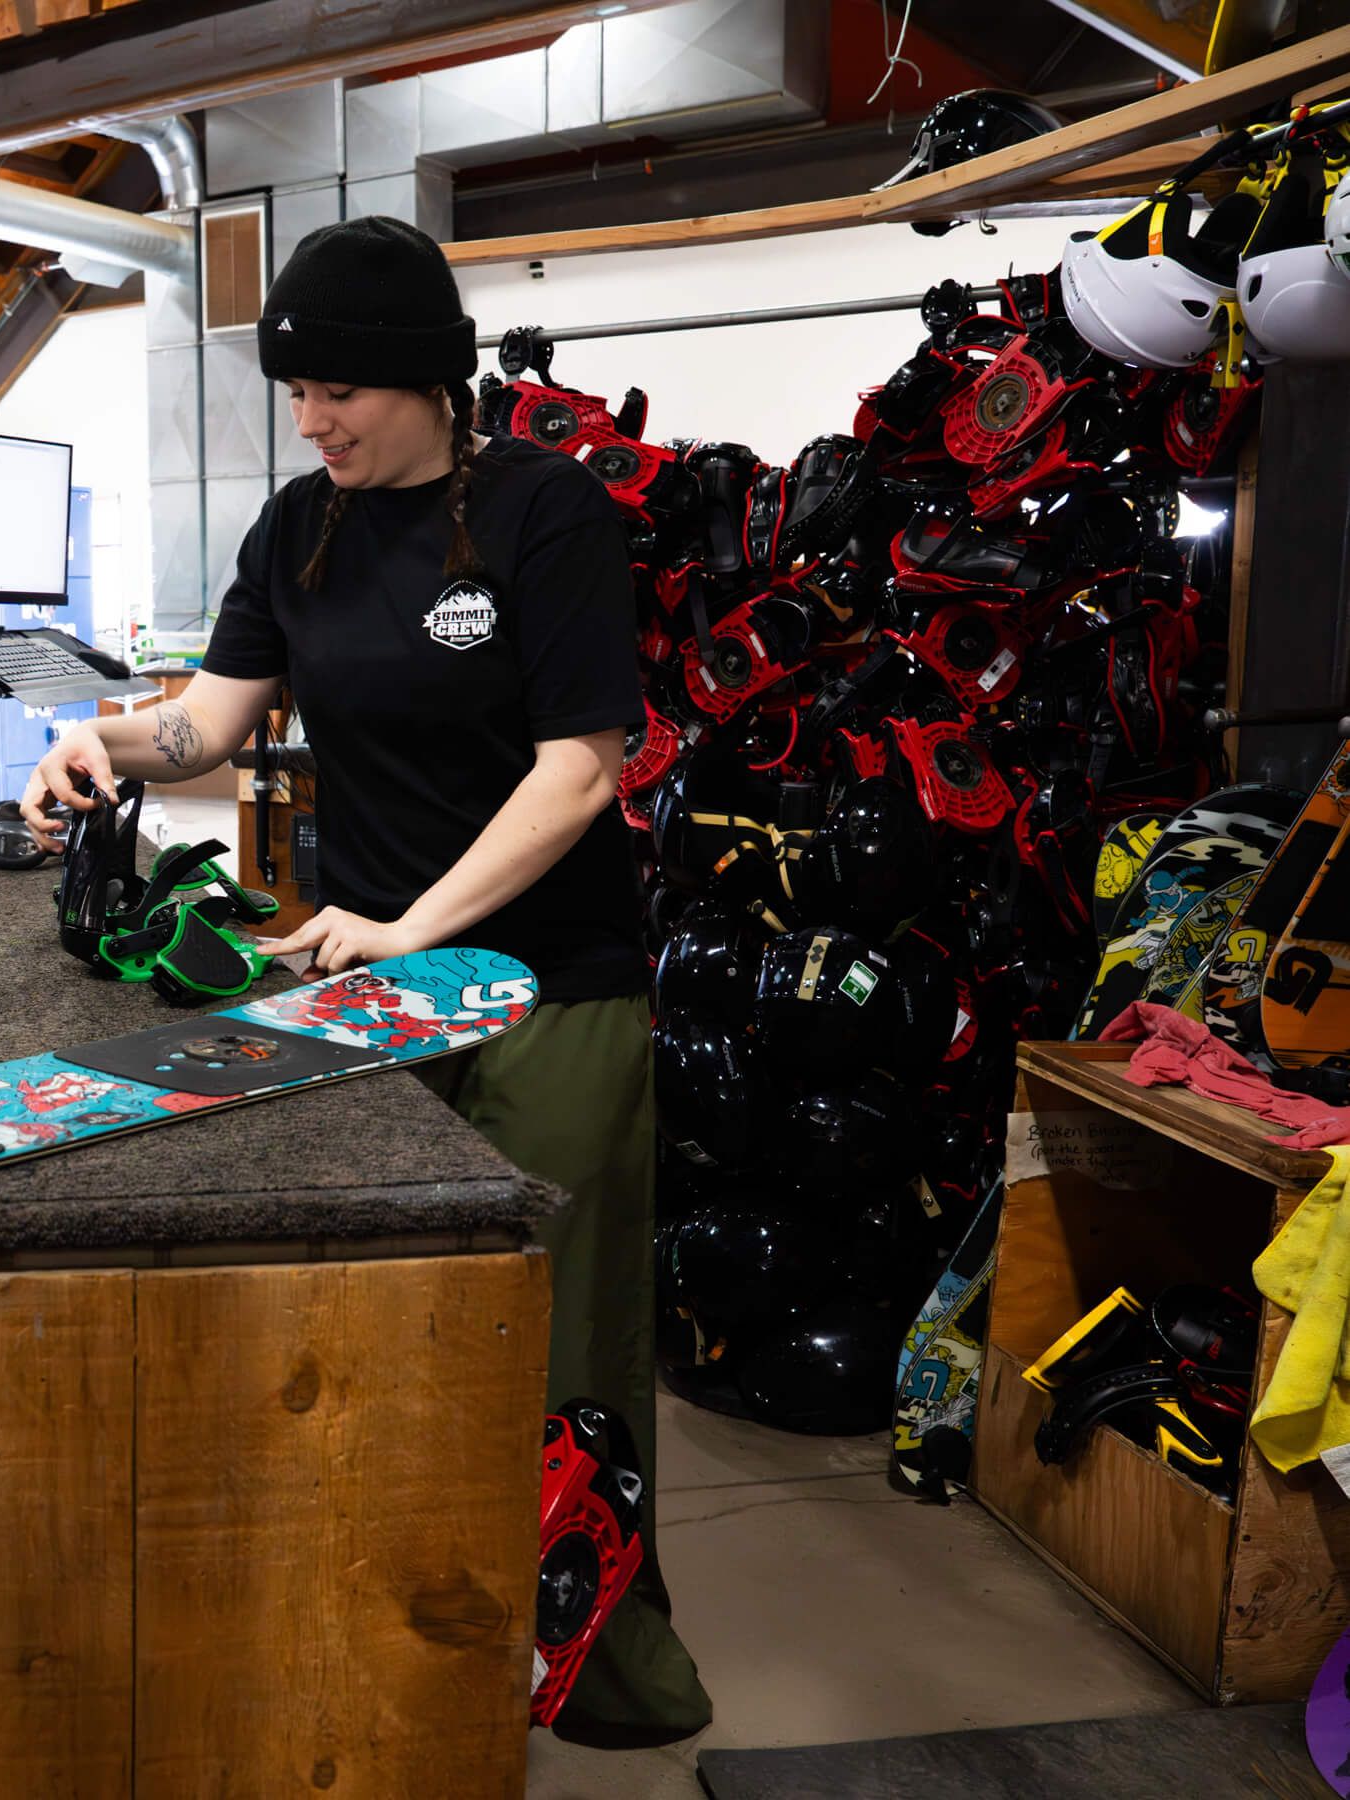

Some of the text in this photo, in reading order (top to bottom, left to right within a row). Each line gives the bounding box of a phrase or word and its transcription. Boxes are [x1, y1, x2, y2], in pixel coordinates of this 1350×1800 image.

[433, 609, 493, 622] SUMMIT
[435, 622, 490, 636] CREW
[829, 844, 842, 883] HEAD
[1026, 1124, 1082, 1142] Broken
